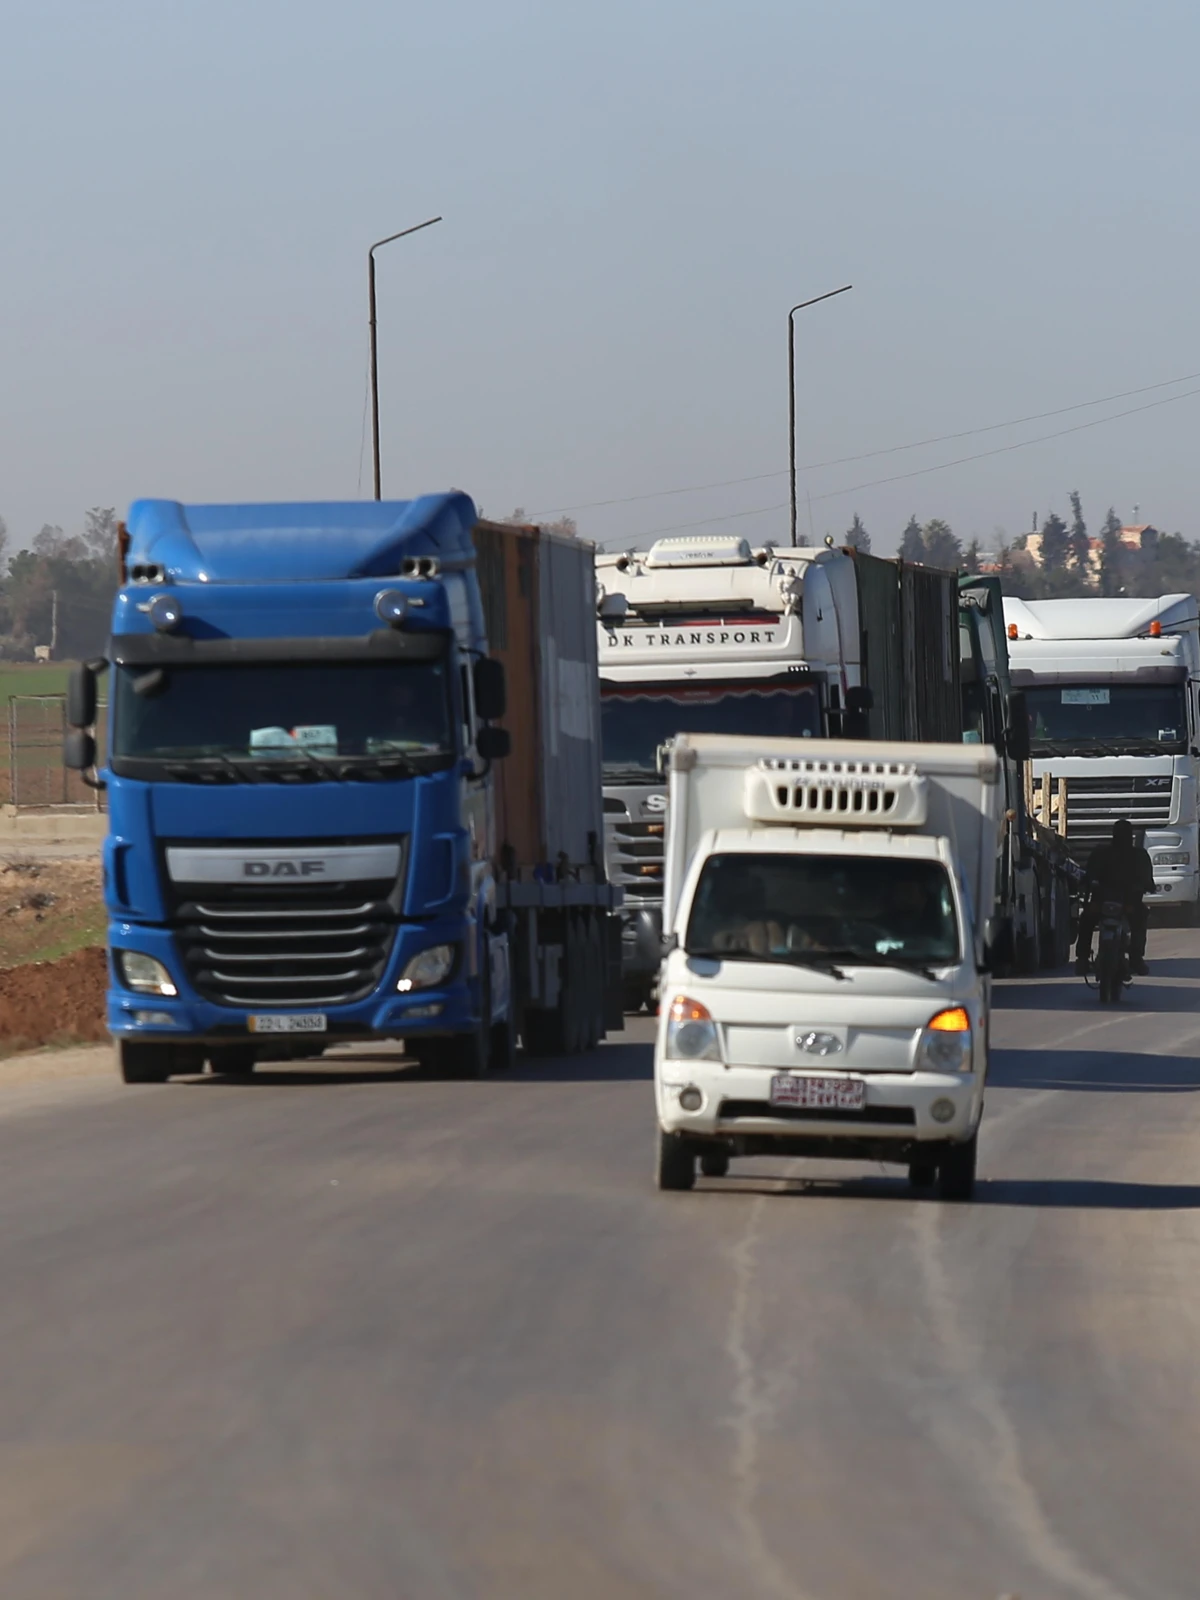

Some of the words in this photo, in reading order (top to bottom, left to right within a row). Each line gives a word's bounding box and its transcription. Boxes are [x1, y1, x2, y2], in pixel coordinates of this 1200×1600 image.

[608, 635, 633, 647] DK
[646, 631, 775, 645] TRANSPORT
[1145, 778, 1170, 786] XF
[243, 860, 326, 877] DAF
